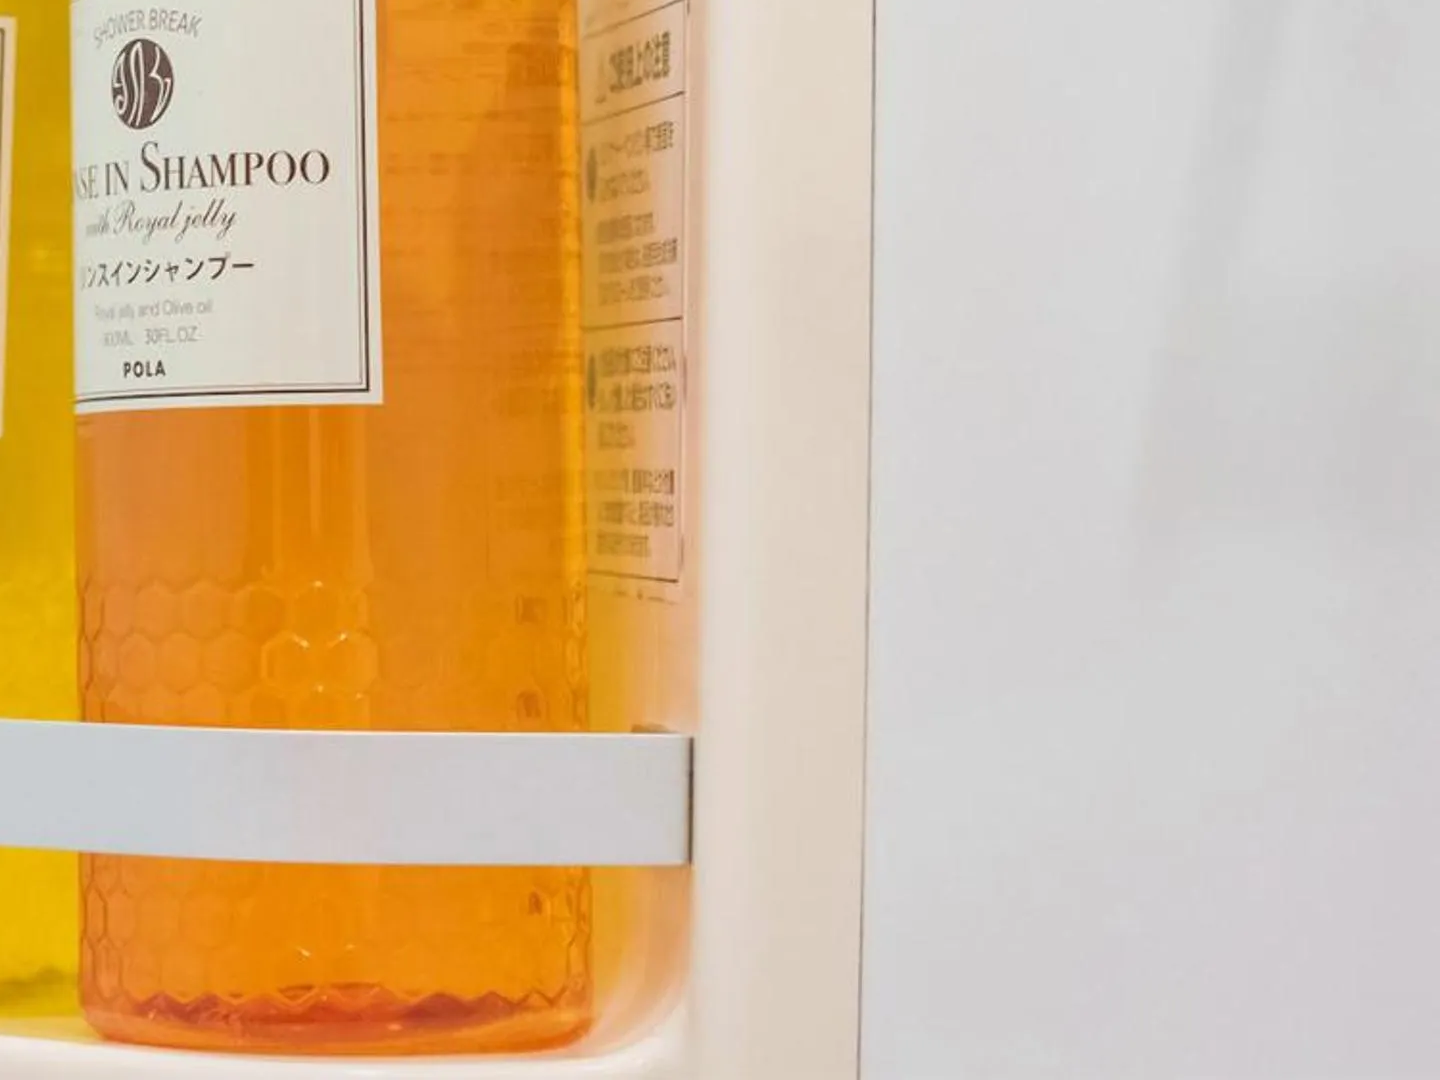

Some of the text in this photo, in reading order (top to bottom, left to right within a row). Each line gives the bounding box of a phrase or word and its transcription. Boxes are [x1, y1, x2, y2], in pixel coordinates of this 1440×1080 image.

[94, 8, 204, 48] SHOWER BREAK
[112, 199, 183, 244] Royal
[175, 198, 237, 243] jelly
[123, 359, 166, 379] POLA
